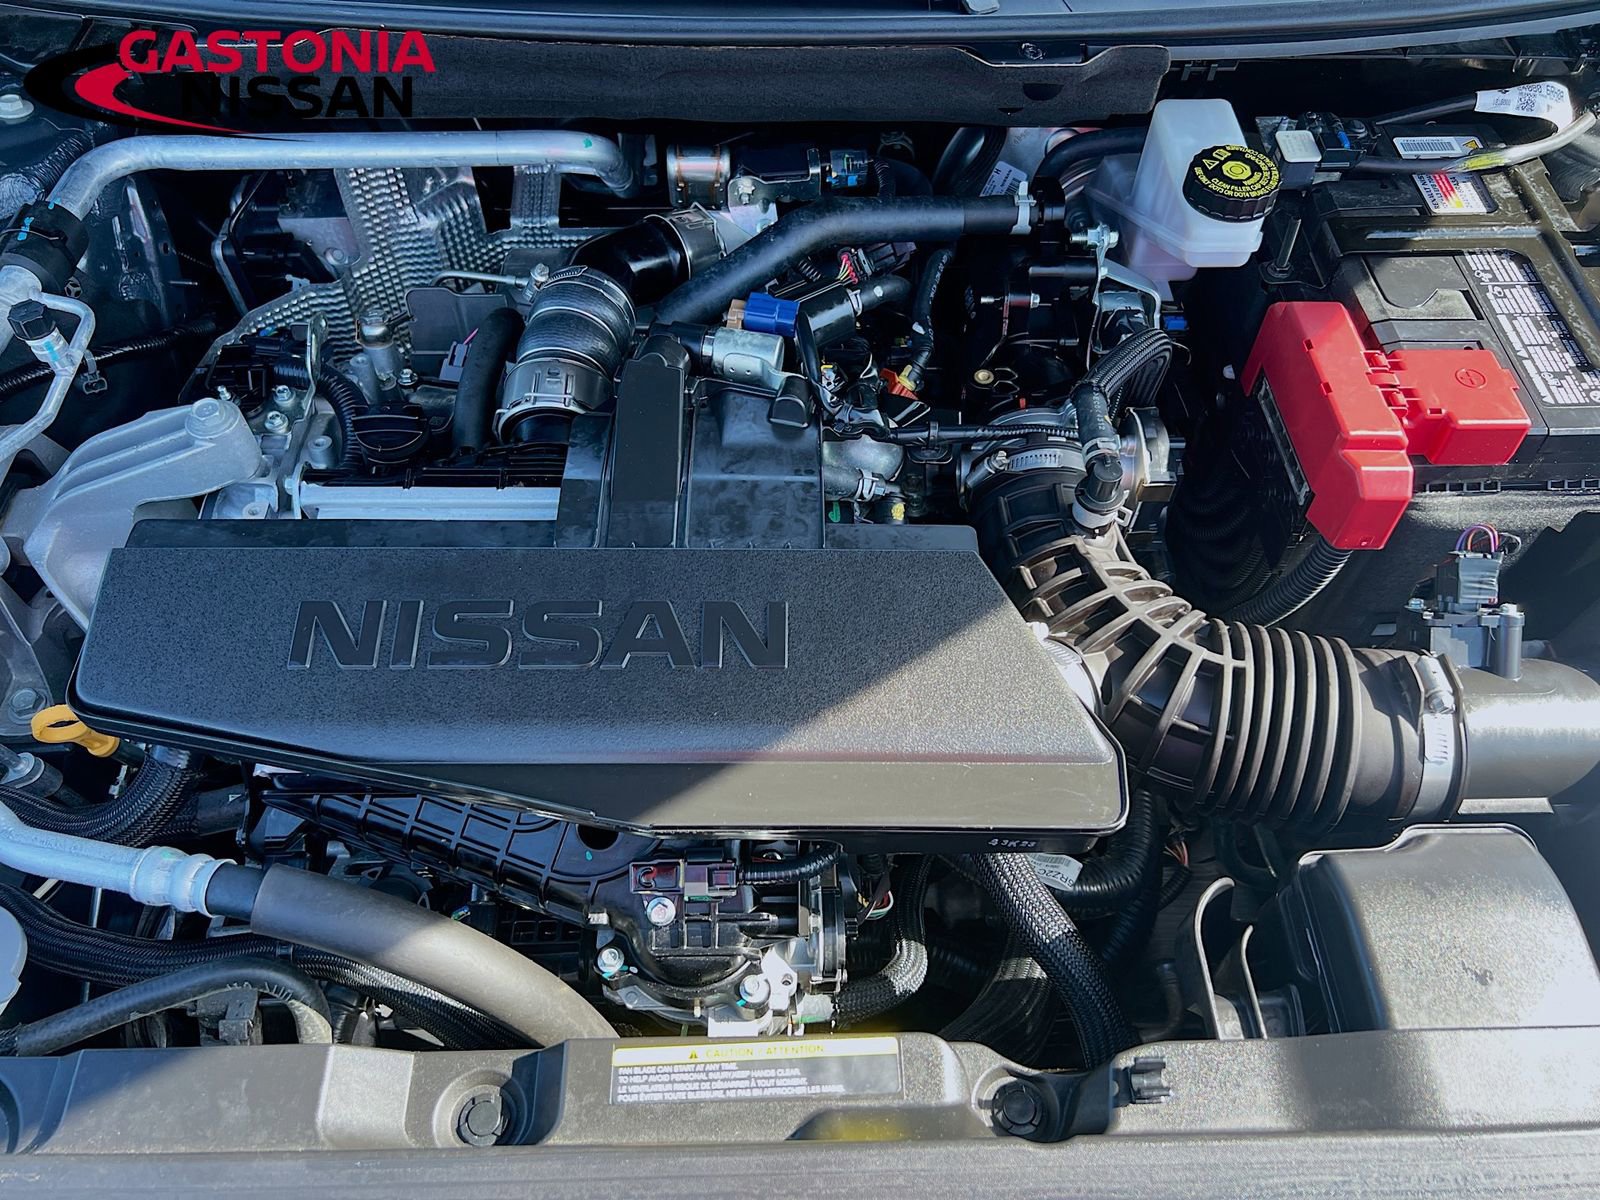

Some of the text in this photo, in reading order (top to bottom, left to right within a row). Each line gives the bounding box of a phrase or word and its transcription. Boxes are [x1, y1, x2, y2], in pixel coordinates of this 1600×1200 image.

[287, 599, 789, 671] NISSAN
[706, 1047, 754, 1058] CAUTION
[766, 1045, 825, 1056] ATTENTION
